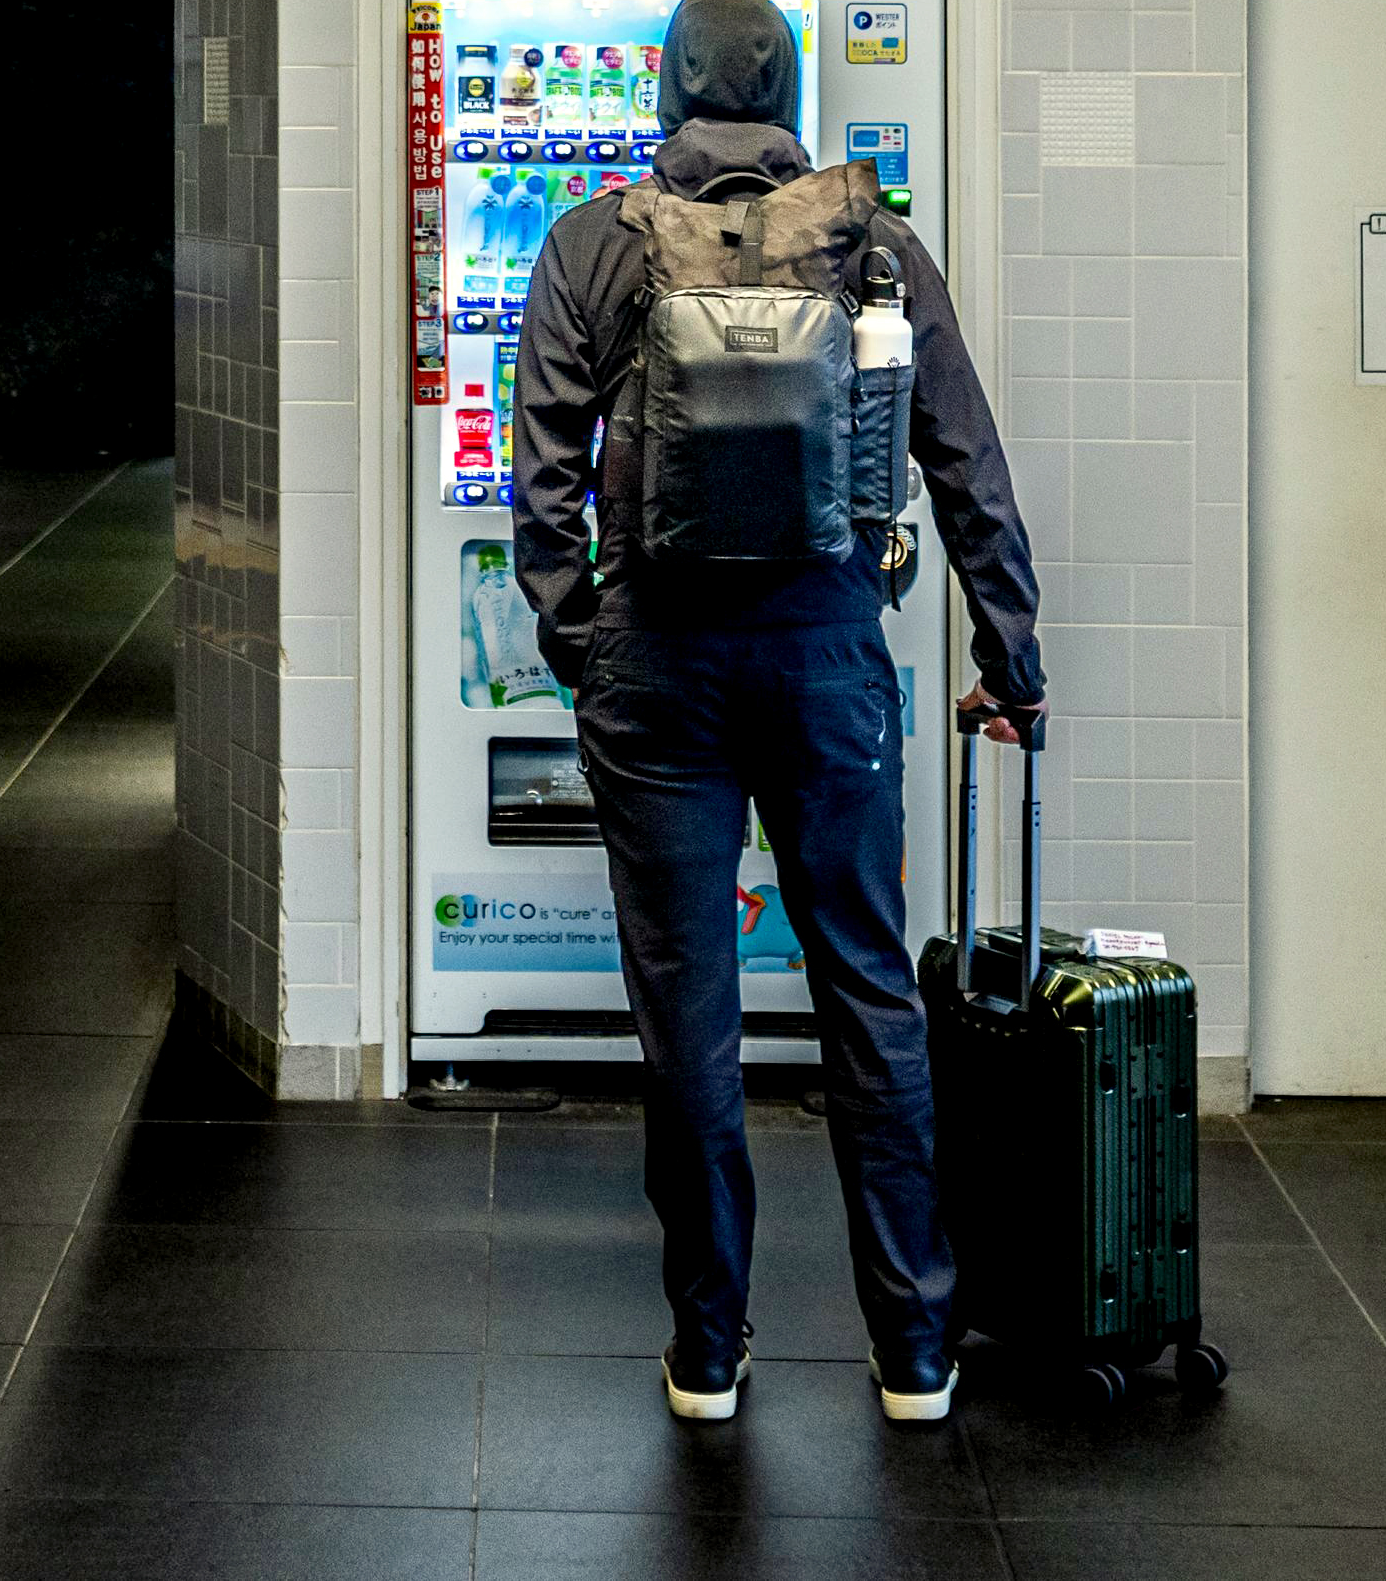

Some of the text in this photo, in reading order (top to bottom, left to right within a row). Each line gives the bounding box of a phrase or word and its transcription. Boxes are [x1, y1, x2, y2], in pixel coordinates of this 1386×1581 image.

[410, 22, 442, 31] Japan
[411, 38, 426, 108] 如何使用
[430, 93, 442, 125] to
[462, 101, 490, 109] BLACK
[412, 111, 428, 181] 사용방법
[429, 134, 443, 179] Use
[733, 333, 769, 343] TENBA
[444, 899, 536, 920] curico
[540, 908, 549, 920] is
[440, 931, 477, 946] Enjoy
[479, 934, 509, 946] your
[513, 931, 563, 946] special
[566, 931, 596, 943] time
